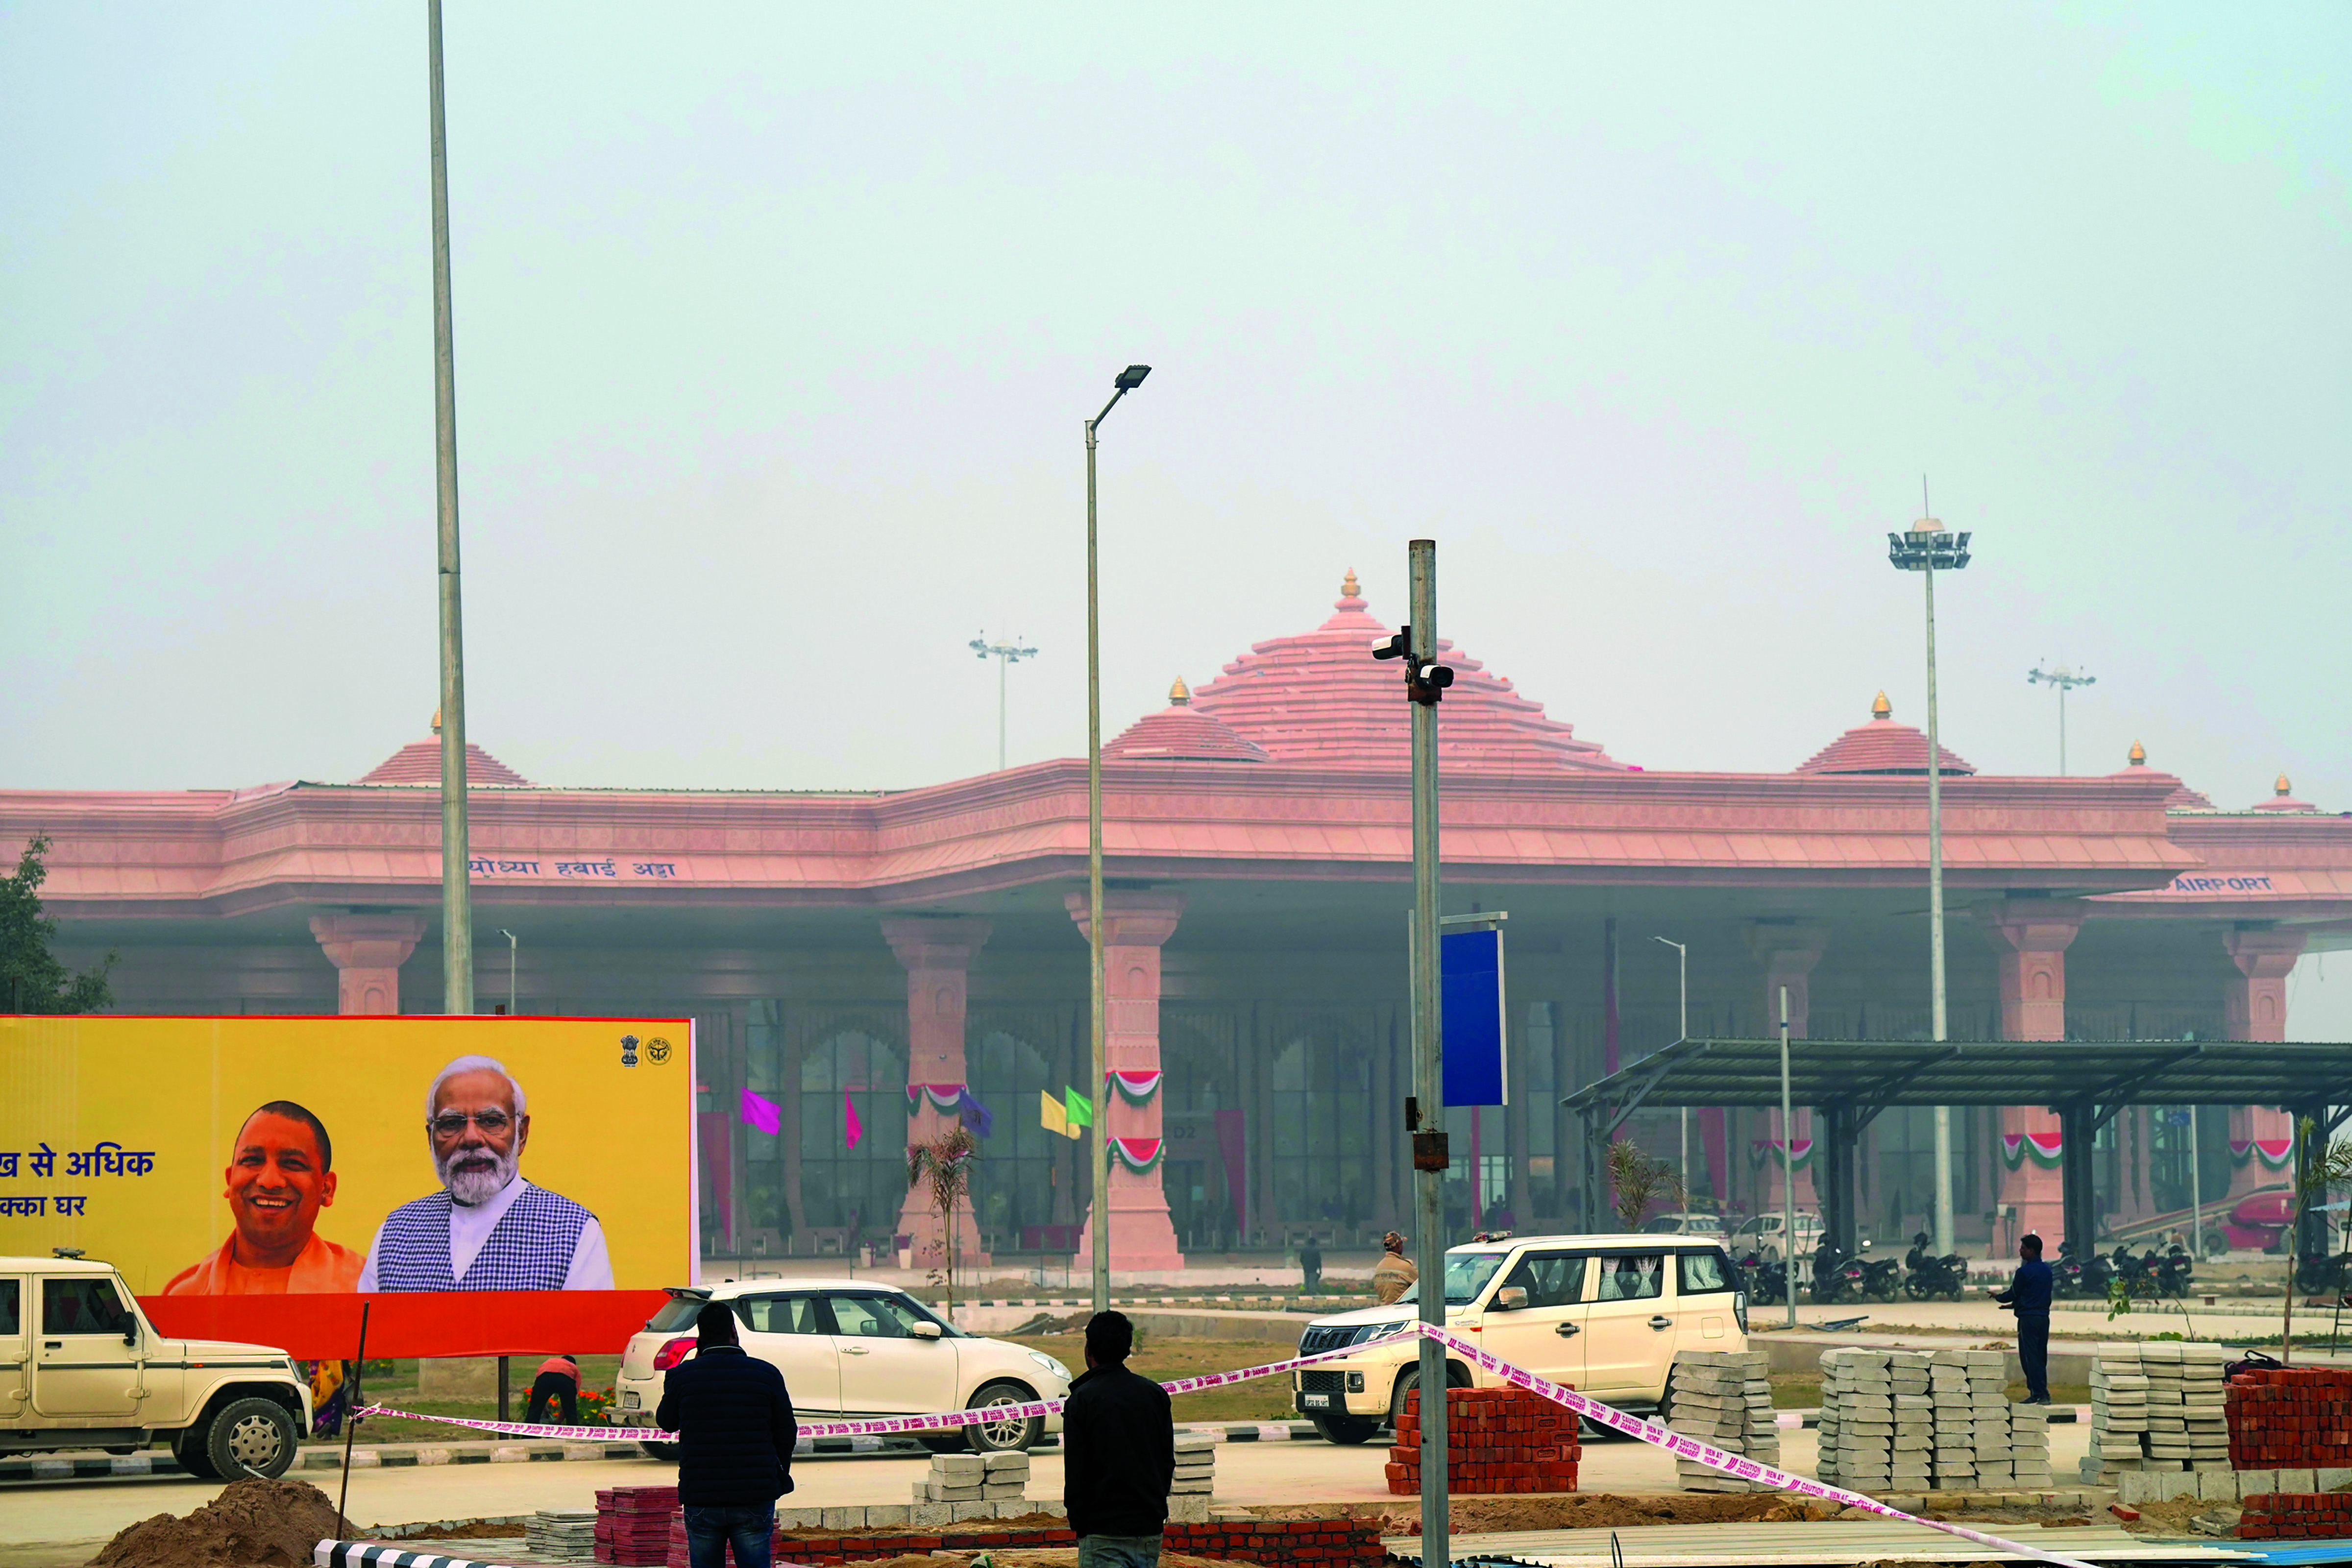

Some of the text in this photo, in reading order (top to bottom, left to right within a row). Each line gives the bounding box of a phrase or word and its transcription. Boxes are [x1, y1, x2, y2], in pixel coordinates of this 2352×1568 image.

[469, 856, 539, 874] योध्या
[2175, 877, 2272, 892] AIRPORT
[28, 1142, 57, 1178] से
[66, 1141, 155, 1177] अधिक
[53, 1196, 87, 1216] घर
[1252, 1367, 1270, 1375] DANGER
[1512, 1367, 1531, 1379] CAUTION
[1206, 1377, 1223, 1385] DANGER
[1511, 1374, 1531, 1387] DANGER
[1535, 1377, 1544, 1386] MEN
[1566, 1391, 1586, 1403] CAUTION
[1565, 1398, 1586, 1411] DANGER
[1590, 1400, 1599, 1410] MEN
[1590, 1409, 1604, 1420] WORK
[1622, 1415, 1642, 1429] CAUTION
[1620, 1422, 1642, 1435] DANGER
[1647, 1424, 1656, 1433] MEN
[1646, 1433, 1661, 1443] WORK
[1680, 1439, 1701, 1452] CAUTION
[1705, 1447, 1715, 1456] MEN
[1677, 1446, 1700, 1458] DANGER
[1703, 1456, 1719, 1466] WORK
[1740, 1460, 1762, 1473] CAUTION
[1736, 1468, 1761, 1478] DANGER
[1766, 1470, 1777, 1479] MEN
[1801, 1482, 1824, 1496] CAUTION
[1830, 1491, 1840, 1499] MEN
